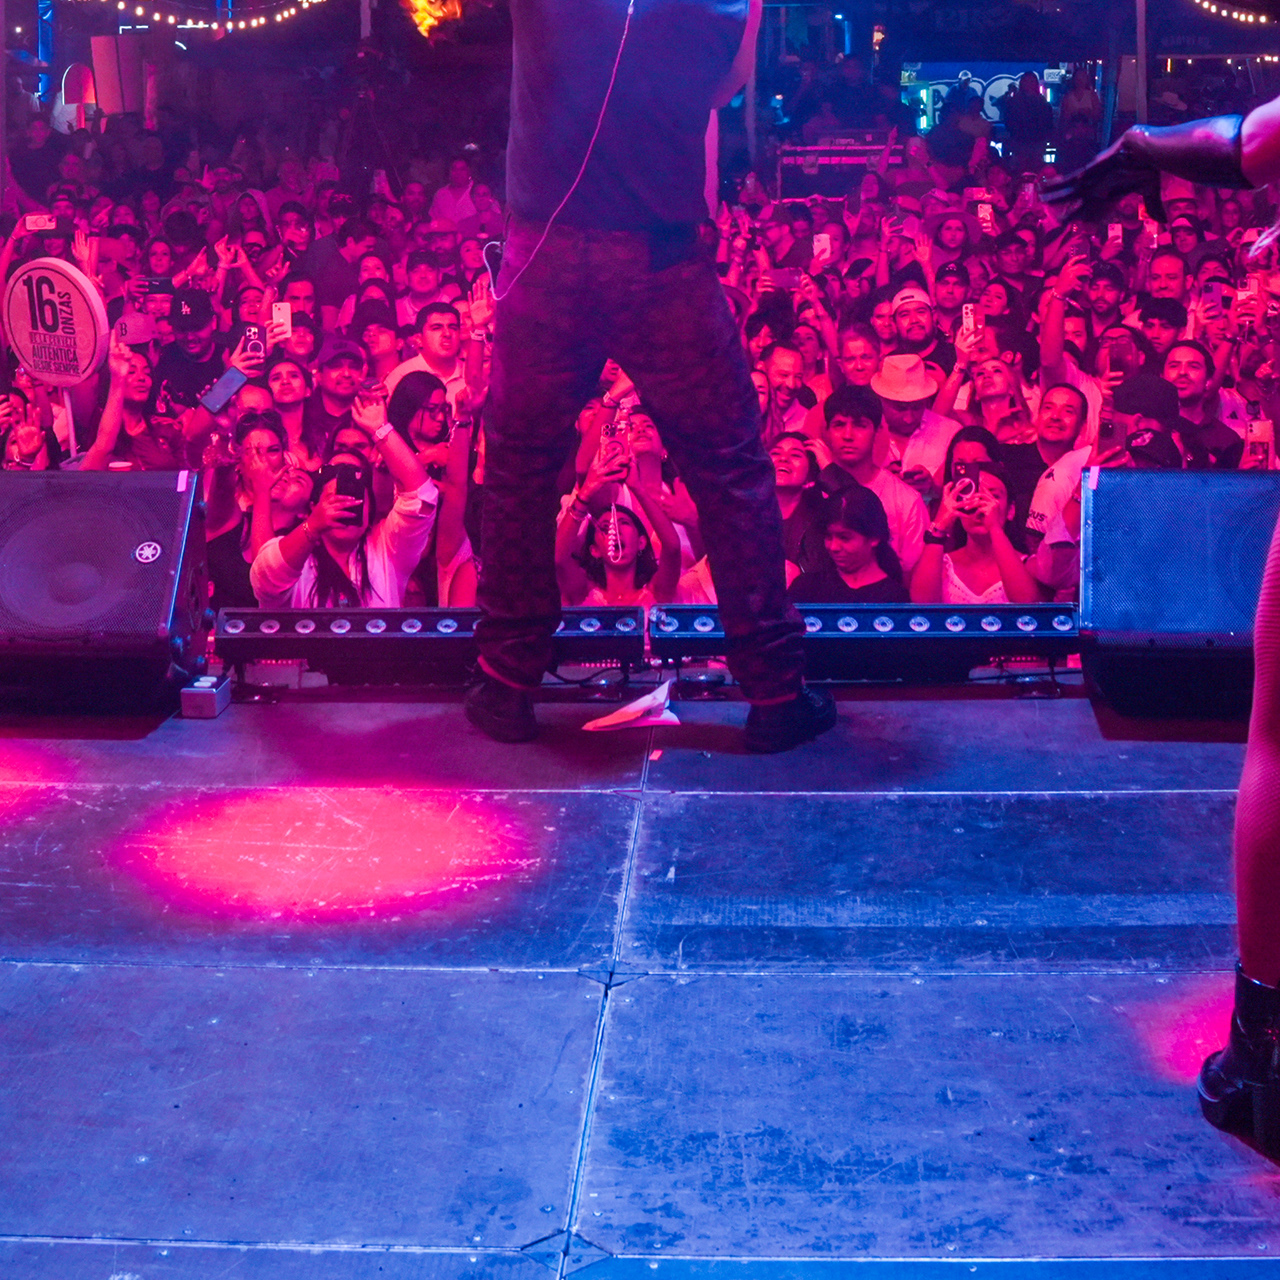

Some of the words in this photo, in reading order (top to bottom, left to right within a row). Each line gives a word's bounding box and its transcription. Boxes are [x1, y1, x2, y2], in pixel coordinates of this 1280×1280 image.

[22, 275, 60, 333] 16
[57, 291, 76, 335] ONZAS
[32, 345, 79, 363] AUTENTICA
